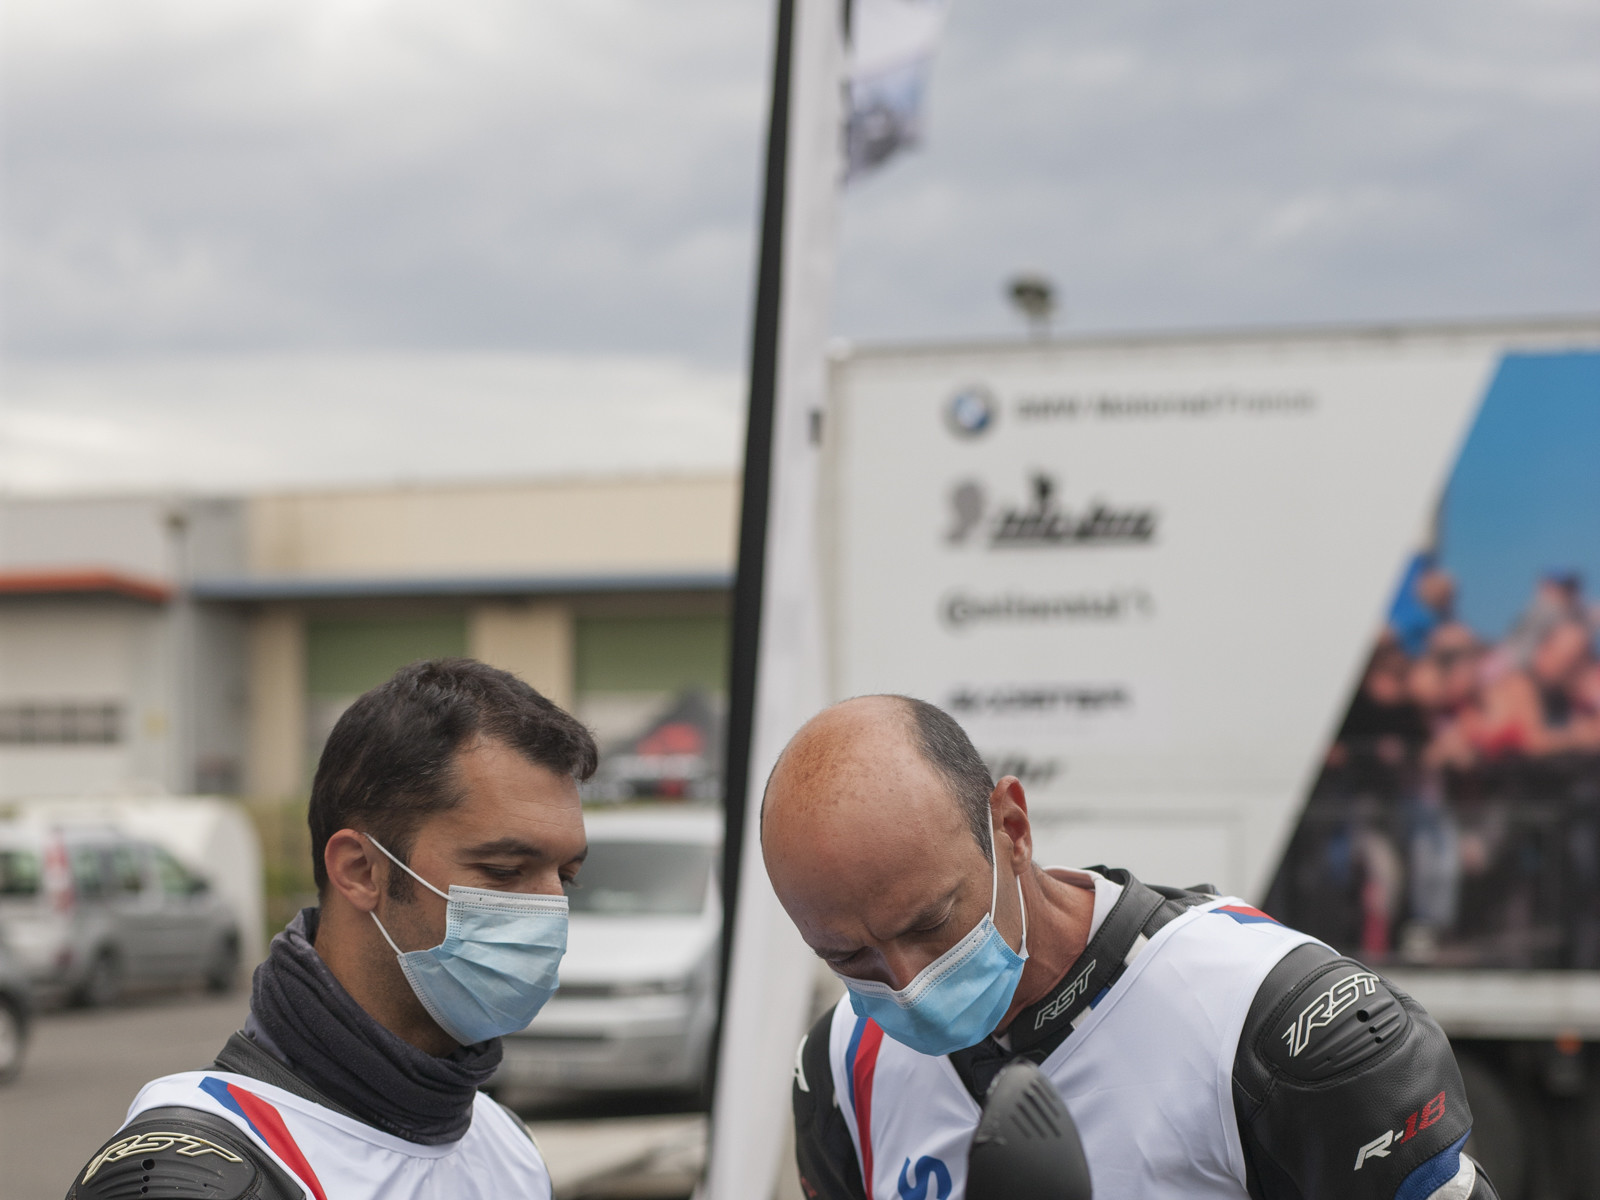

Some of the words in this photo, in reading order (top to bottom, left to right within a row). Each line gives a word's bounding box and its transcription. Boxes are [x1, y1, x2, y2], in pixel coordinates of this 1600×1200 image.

[1033, 958, 1097, 1031] RST
[1281, 972, 1380, 1058] RST
[82, 1131, 244, 1185] RST
[1353, 1090, 1446, 1171] R-18
